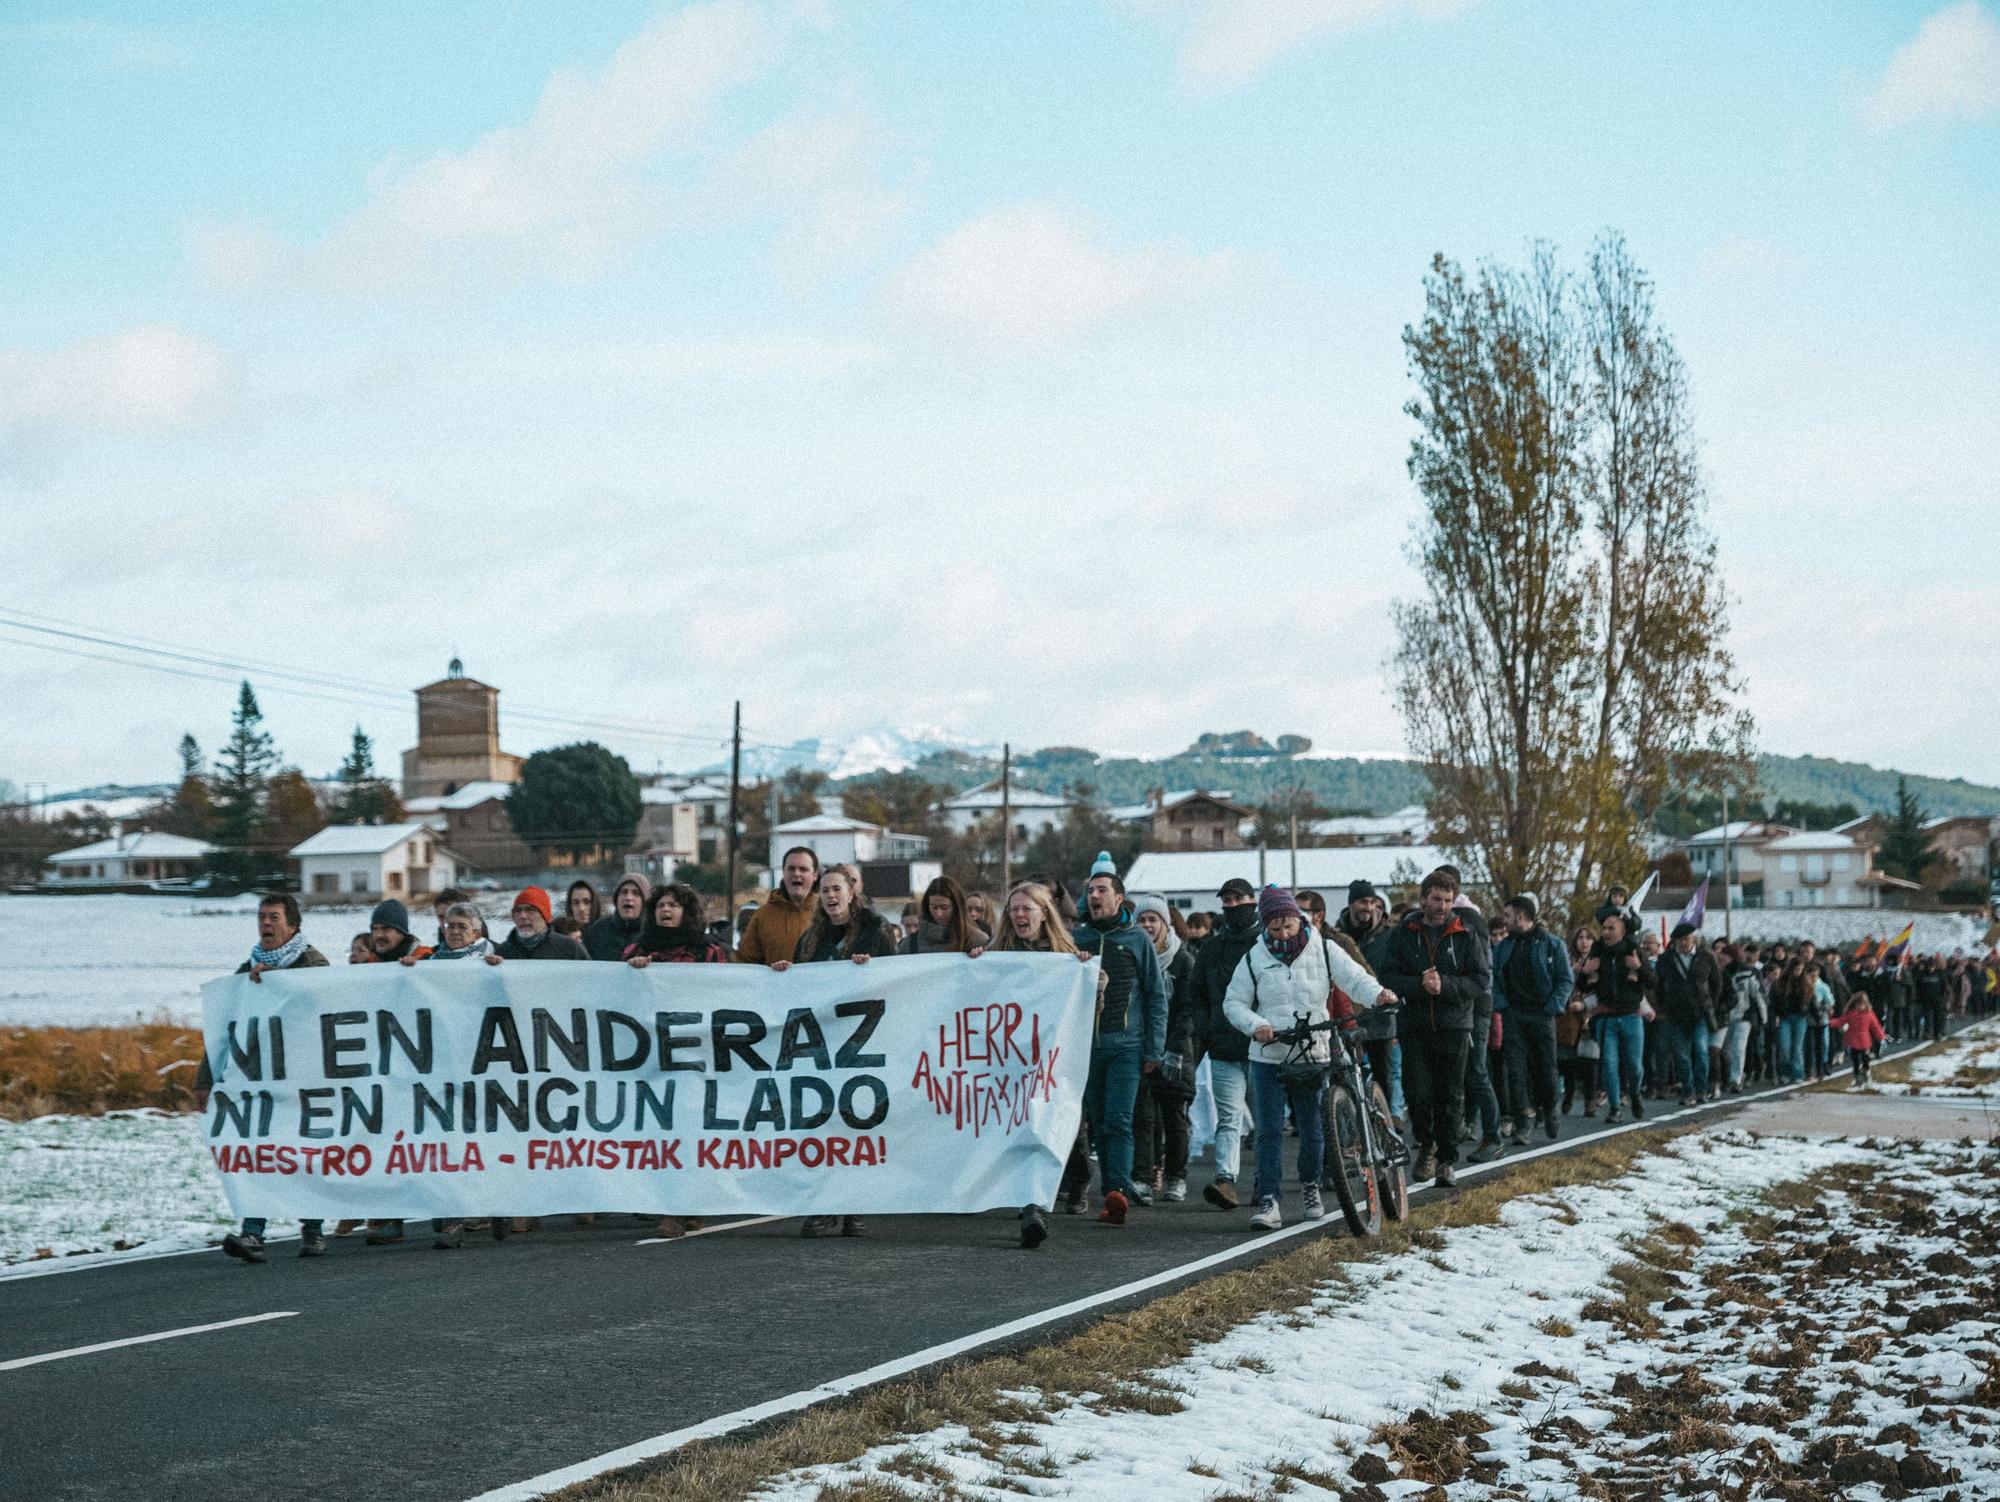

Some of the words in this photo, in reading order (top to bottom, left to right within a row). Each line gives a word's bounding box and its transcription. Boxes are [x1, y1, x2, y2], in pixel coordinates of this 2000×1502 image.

[320, 1008, 433, 1079] EN
[472, 999, 887, 1075] ANDERAZ
[940, 1002, 1040, 1067] HERRI
[210, 1089, 274, 1138] NI
[299, 1083, 382, 1138] EN
[413, 1077, 675, 1134] NINGUN
[703, 1074, 890, 1132] LADO
[211, 1143, 372, 1177] MAESTRO
[385, 1130, 485, 1174] ÁVILA
[527, 1136, 683, 1170] FAXISTAK
[697, 1135, 887, 1170] KANPORA!
